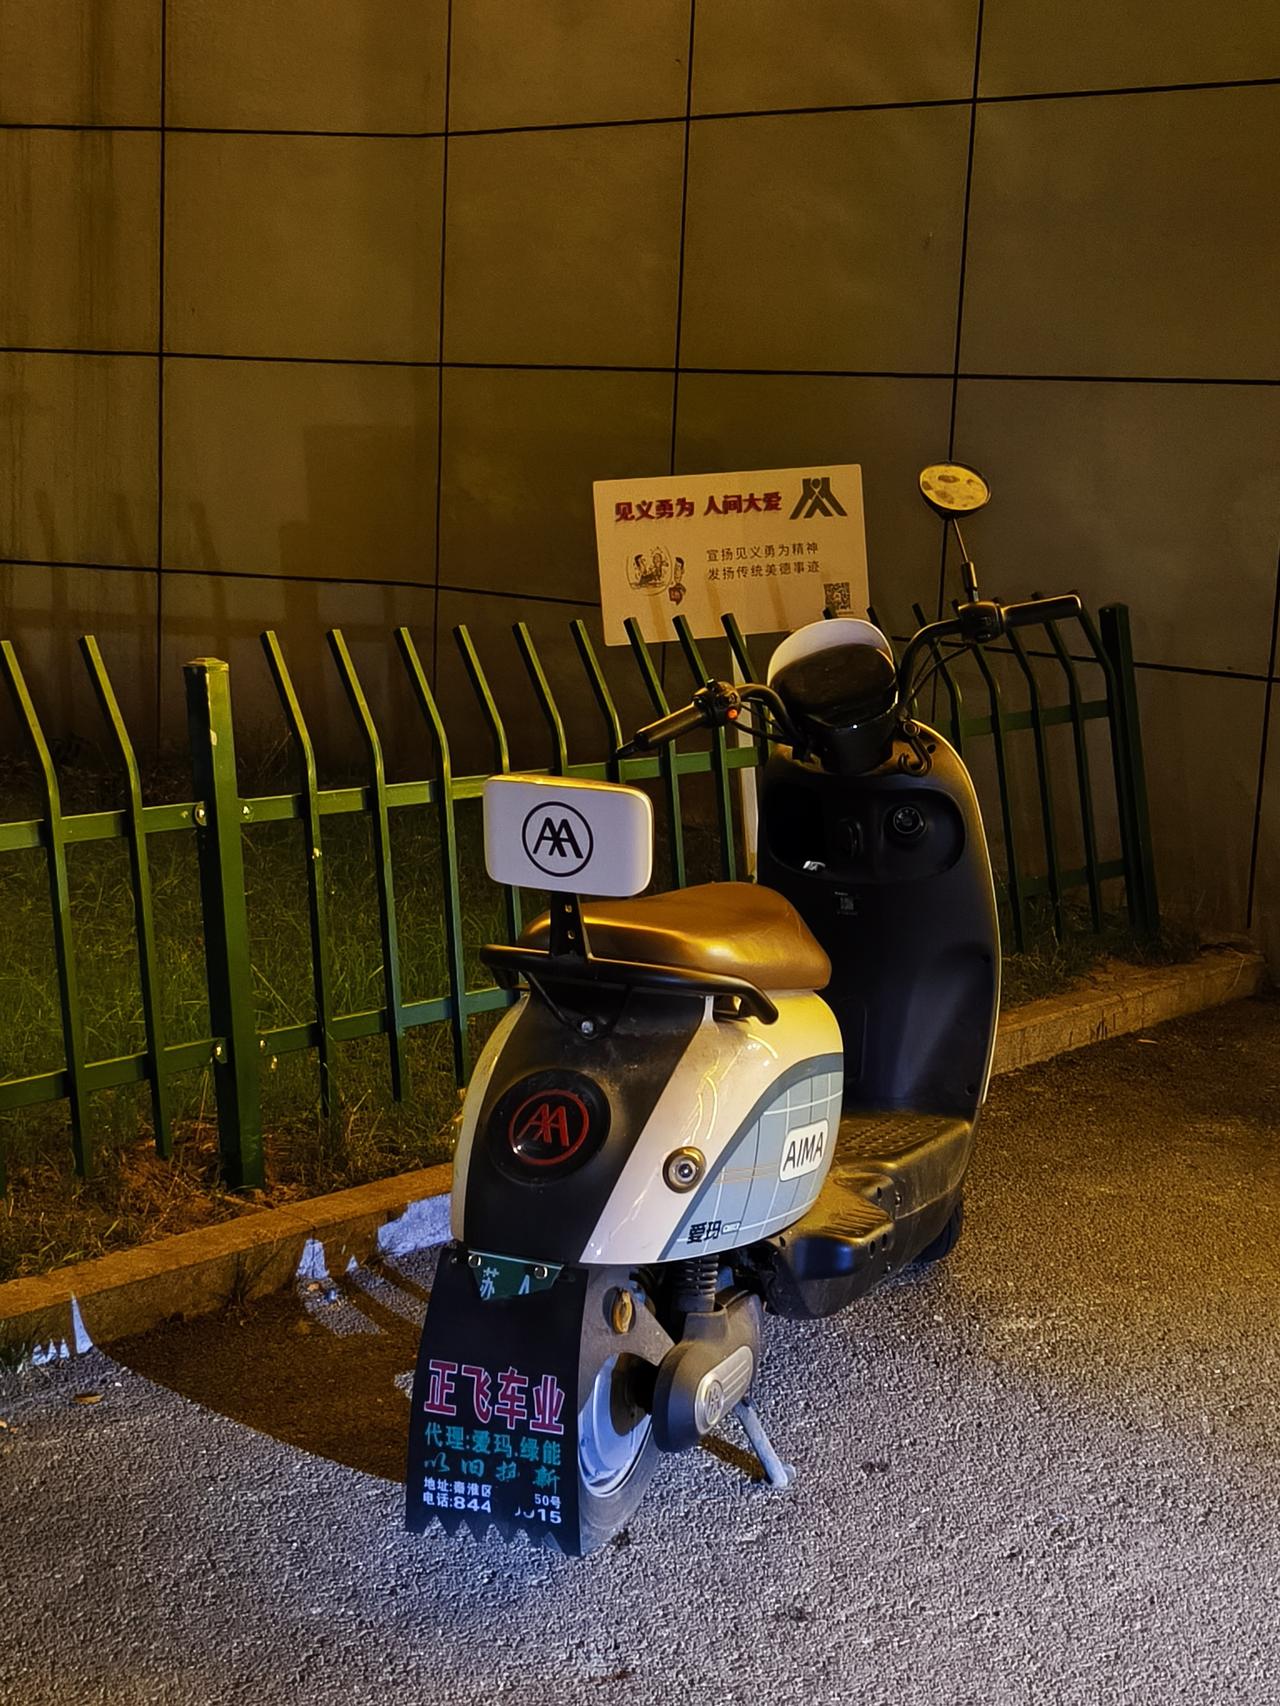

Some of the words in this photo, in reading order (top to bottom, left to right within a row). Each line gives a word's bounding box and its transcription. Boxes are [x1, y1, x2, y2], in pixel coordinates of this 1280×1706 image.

[615, 498, 695, 522] 见义勇为
[704, 492, 782, 516] 人间大爱
[706, 542, 819, 562] 宣扬见义勇为精神
[708, 561, 821, 581] 发扬传统美德事迹
[783, 1131, 824, 1172] AIMA
[687, 1220, 722, 1244] 爱玛
[424, 1359, 565, 1435] 正飞车业
[534, 1493, 561, 1510] 50号
